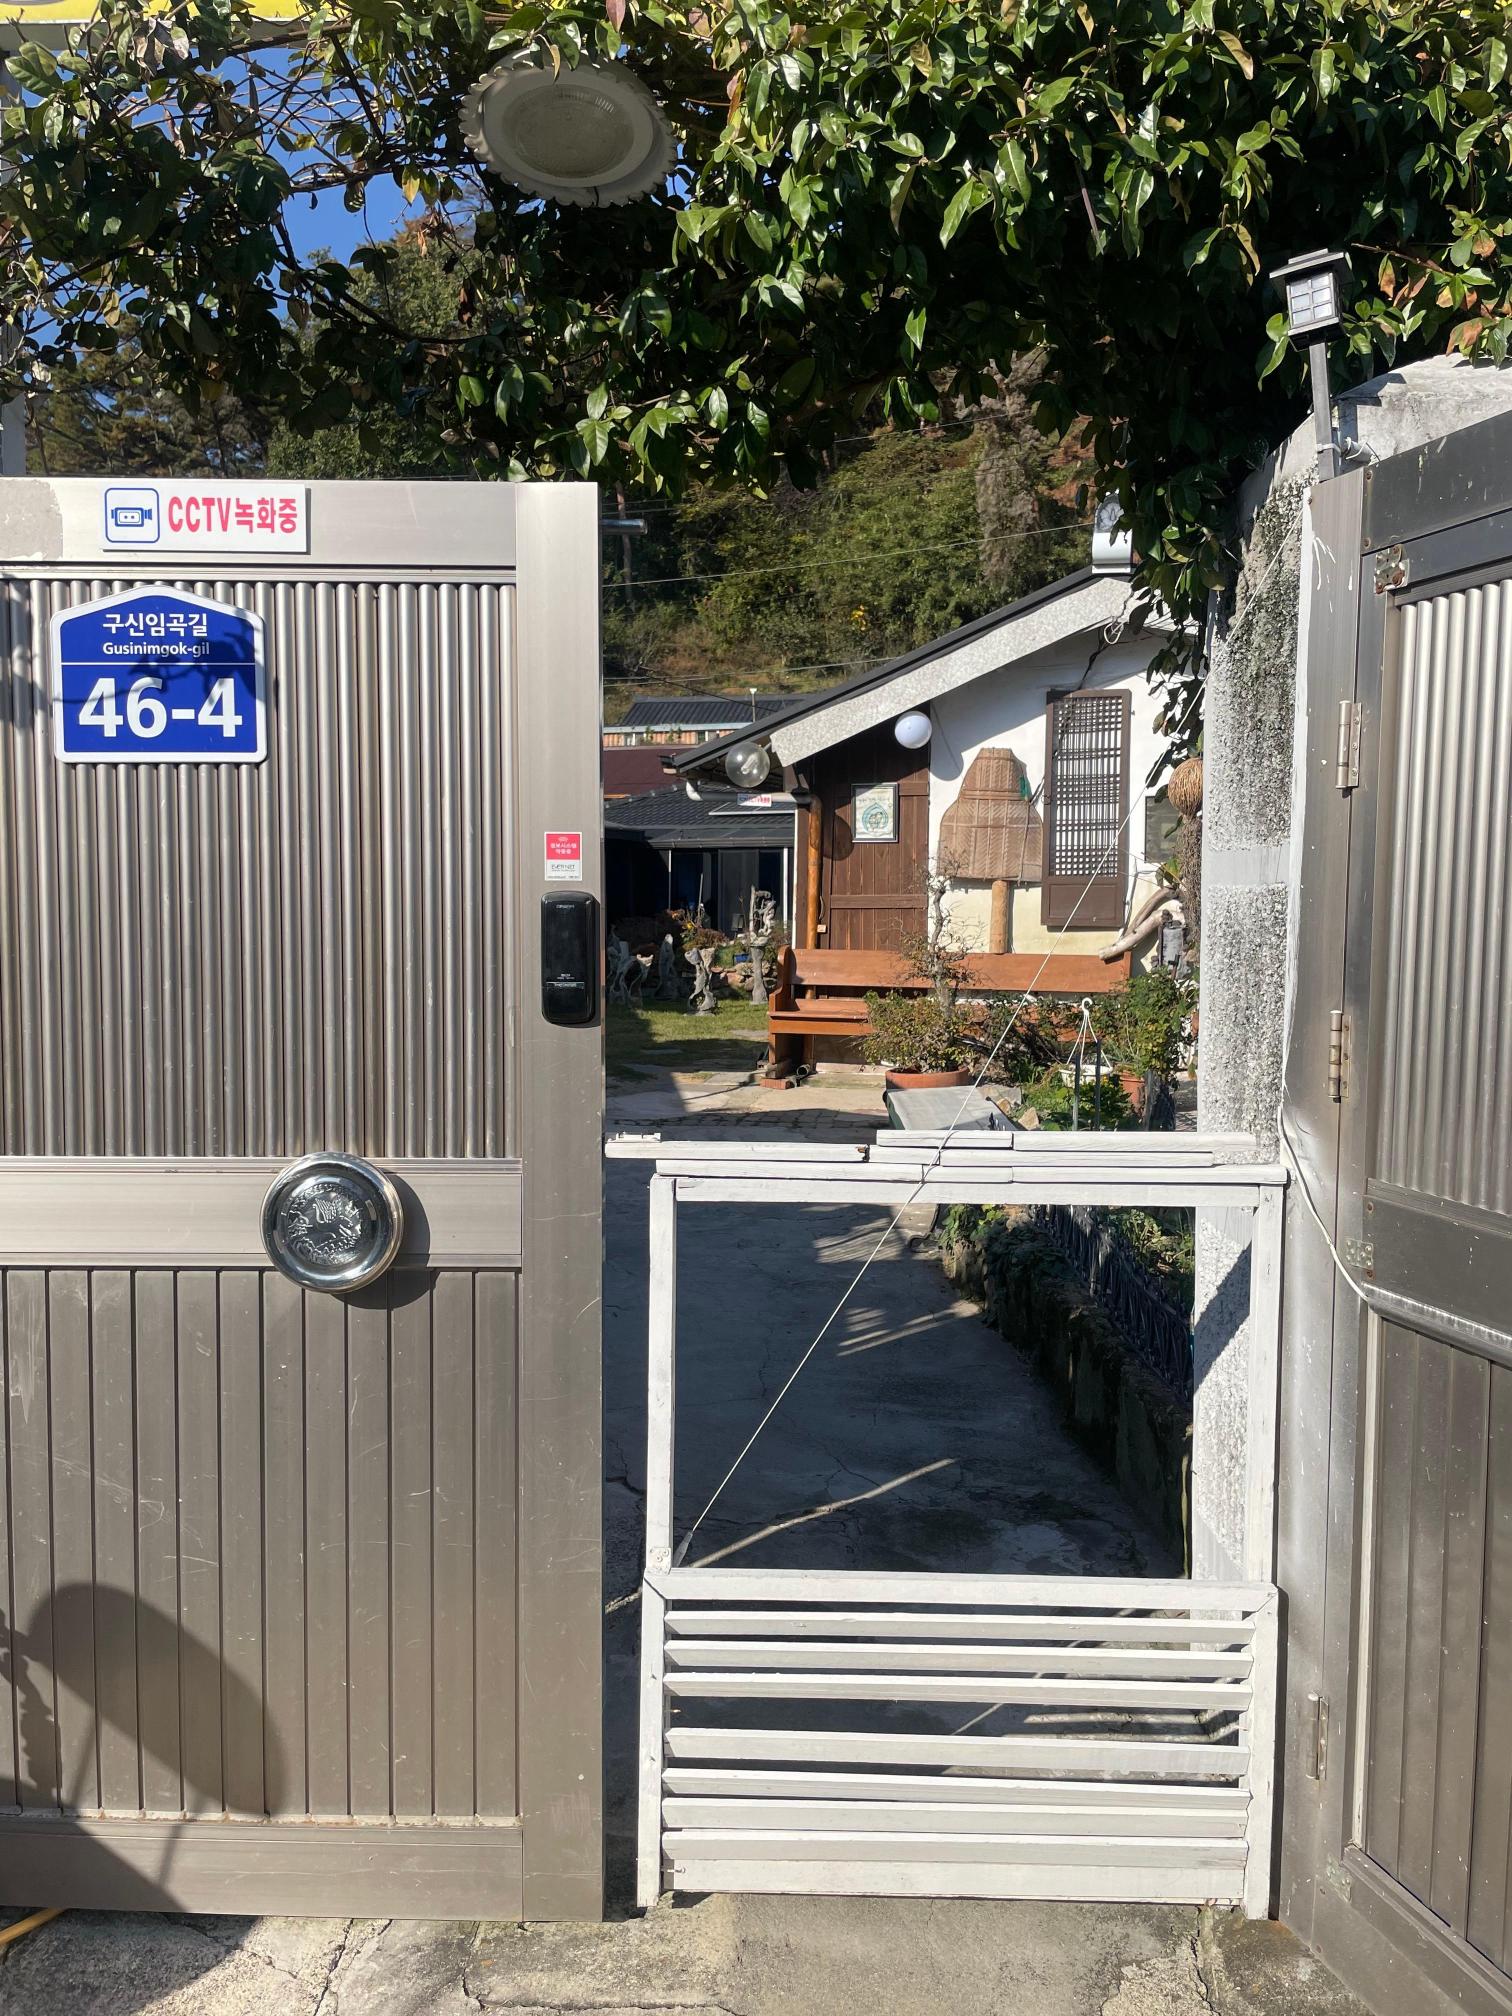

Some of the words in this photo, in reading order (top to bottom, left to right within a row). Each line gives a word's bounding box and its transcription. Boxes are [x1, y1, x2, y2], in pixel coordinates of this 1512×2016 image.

[102, 613, 208, 637] 구신임곡길
[102, 642, 210, 658] Gusinimgok-gil
[78, 676, 243, 738] 46-4
